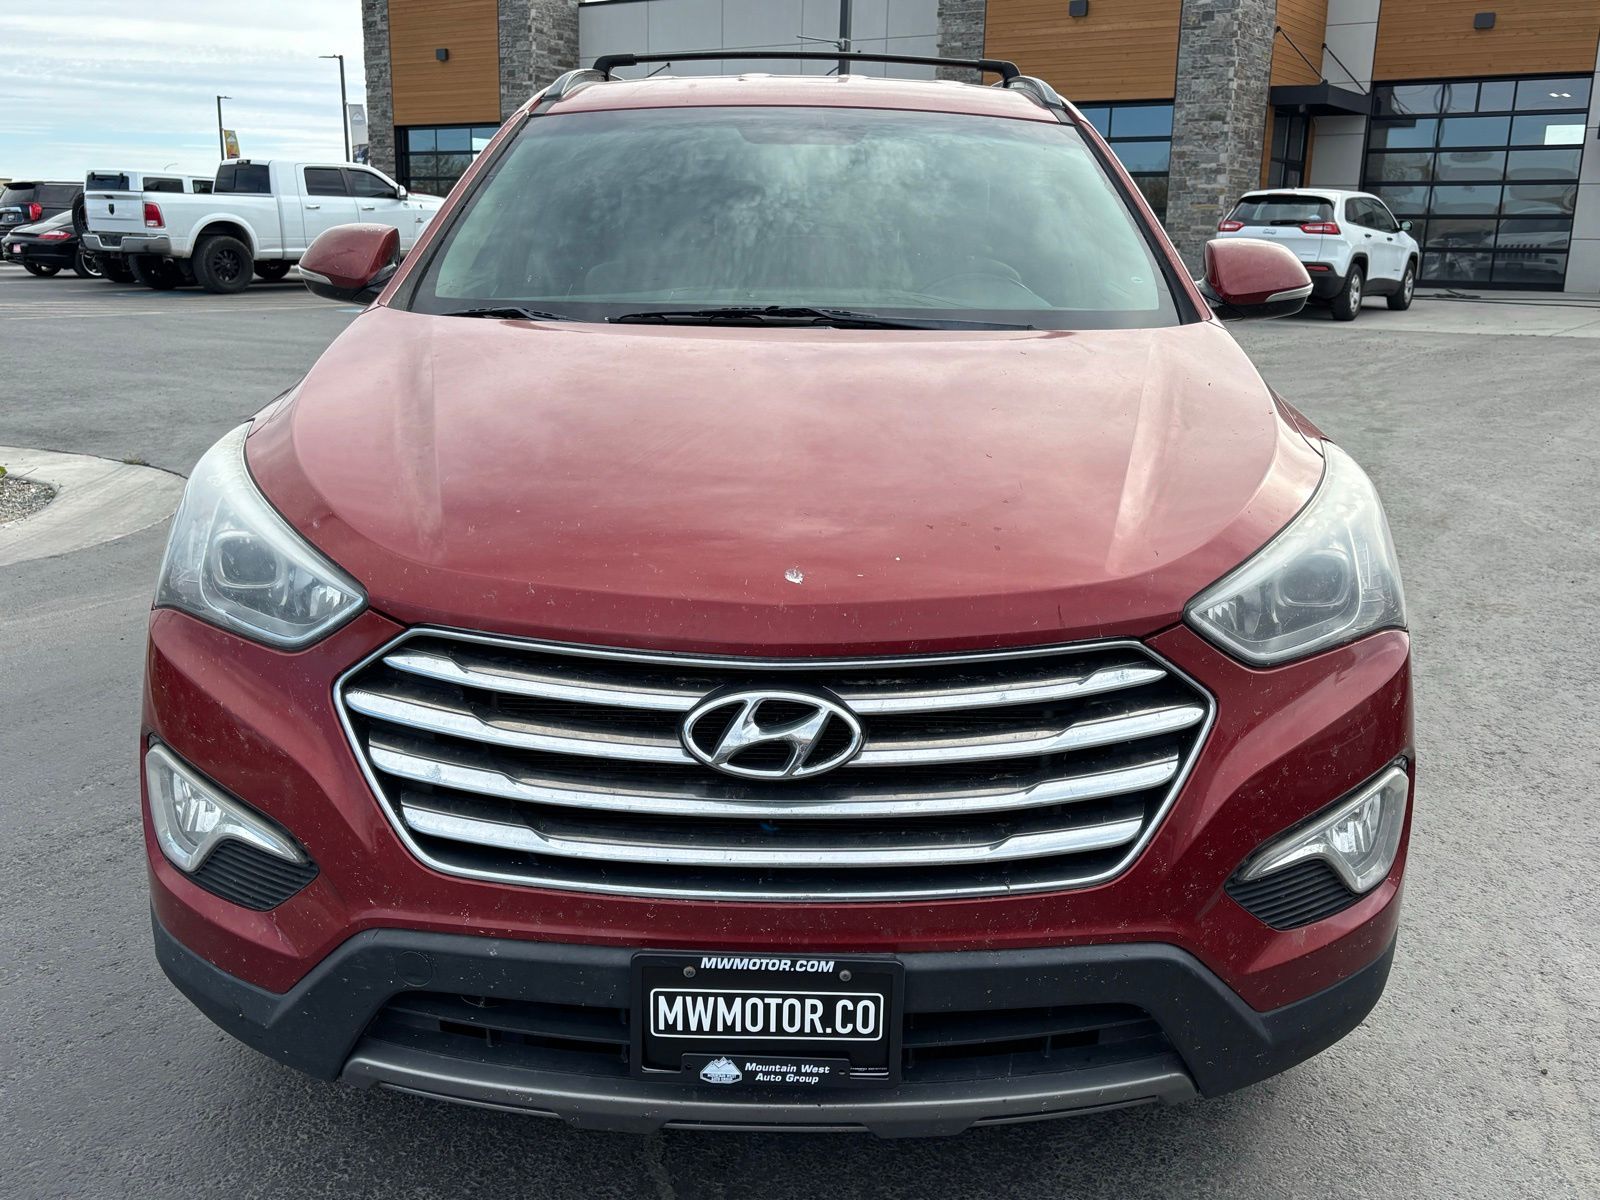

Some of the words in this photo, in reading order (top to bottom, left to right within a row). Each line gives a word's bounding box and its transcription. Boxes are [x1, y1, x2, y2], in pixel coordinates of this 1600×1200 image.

[700, 957, 835, 973] MWMOTOR.COM
[658, 995, 876, 1035] MWMOTOR.CO
[744, 1062, 797, 1074] Mountain
[801, 1064, 830, 1074] West
[755, 1073, 782, 1082] Auto
[786, 1073, 819, 1084] Group
